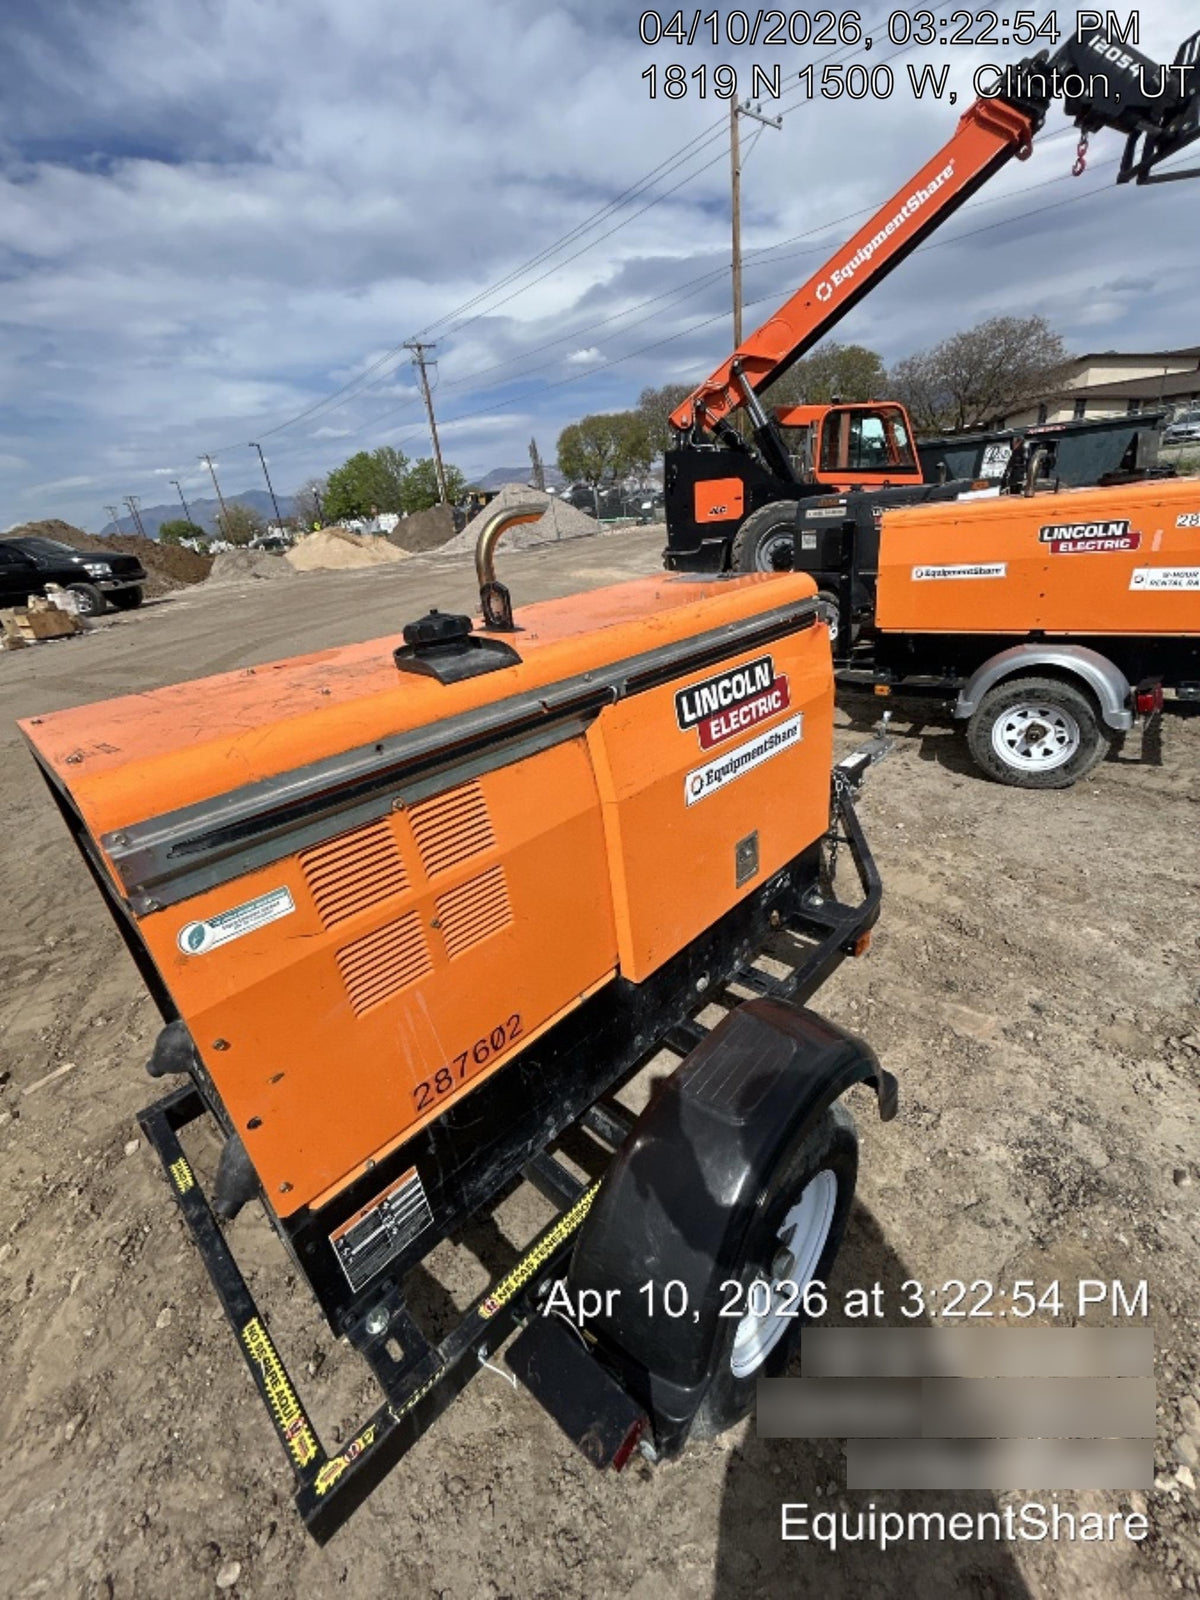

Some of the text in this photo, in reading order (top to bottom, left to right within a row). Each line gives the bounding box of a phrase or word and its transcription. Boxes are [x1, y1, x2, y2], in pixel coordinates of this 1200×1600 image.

[830, 164, 954, 287] EquipmentShare
[1043, 522, 1125, 541] LINCOLN
[1059, 538, 1131, 552] ELECTRIC
[681, 663, 771, 722] LINCOLN
[709, 690, 782, 740] ELECTRIC
[705, 725, 798, 786] EquipmentShare
[413, 1014, 524, 1112] 287602
